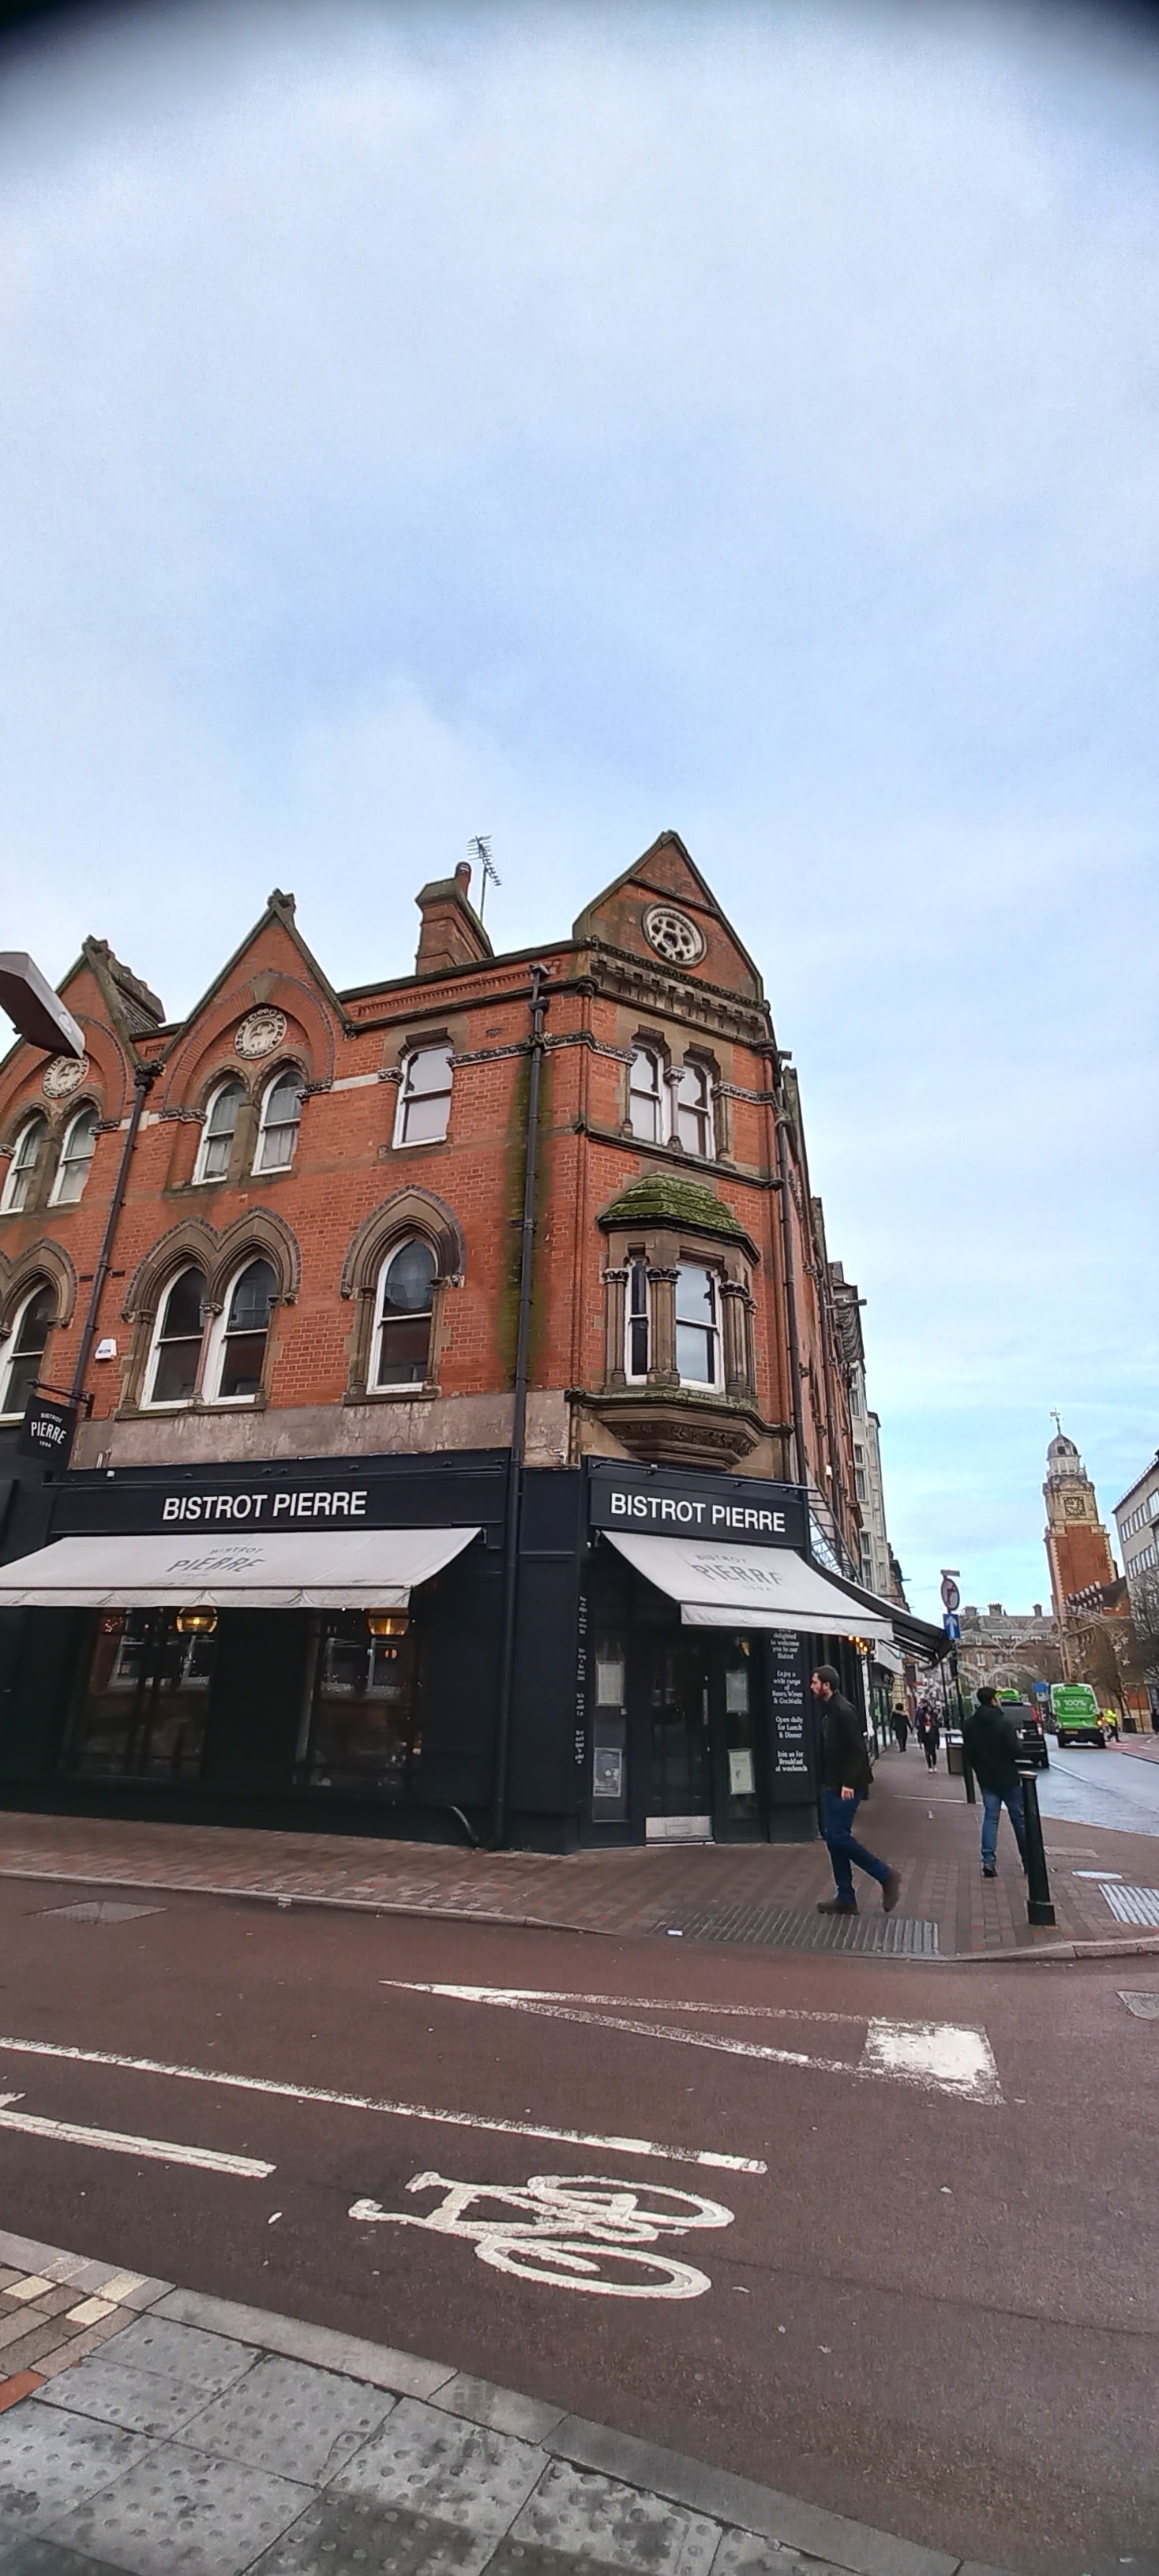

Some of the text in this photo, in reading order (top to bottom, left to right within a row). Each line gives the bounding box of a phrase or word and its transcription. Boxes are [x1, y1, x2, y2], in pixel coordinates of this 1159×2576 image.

[40, 1412, 63, 1423] BISTROT
[31, 1421, 67, 1444] PIERRE
[163, 1491, 368, 1520] BISTROT PIERRE
[610, 1492, 786, 1533] BISTROT PIERRE
[209, 1546, 264, 1555] BISTROT
[165, 1557, 266, 1573] PIERRE
[691, 1564, 784, 1586] PIERRE
